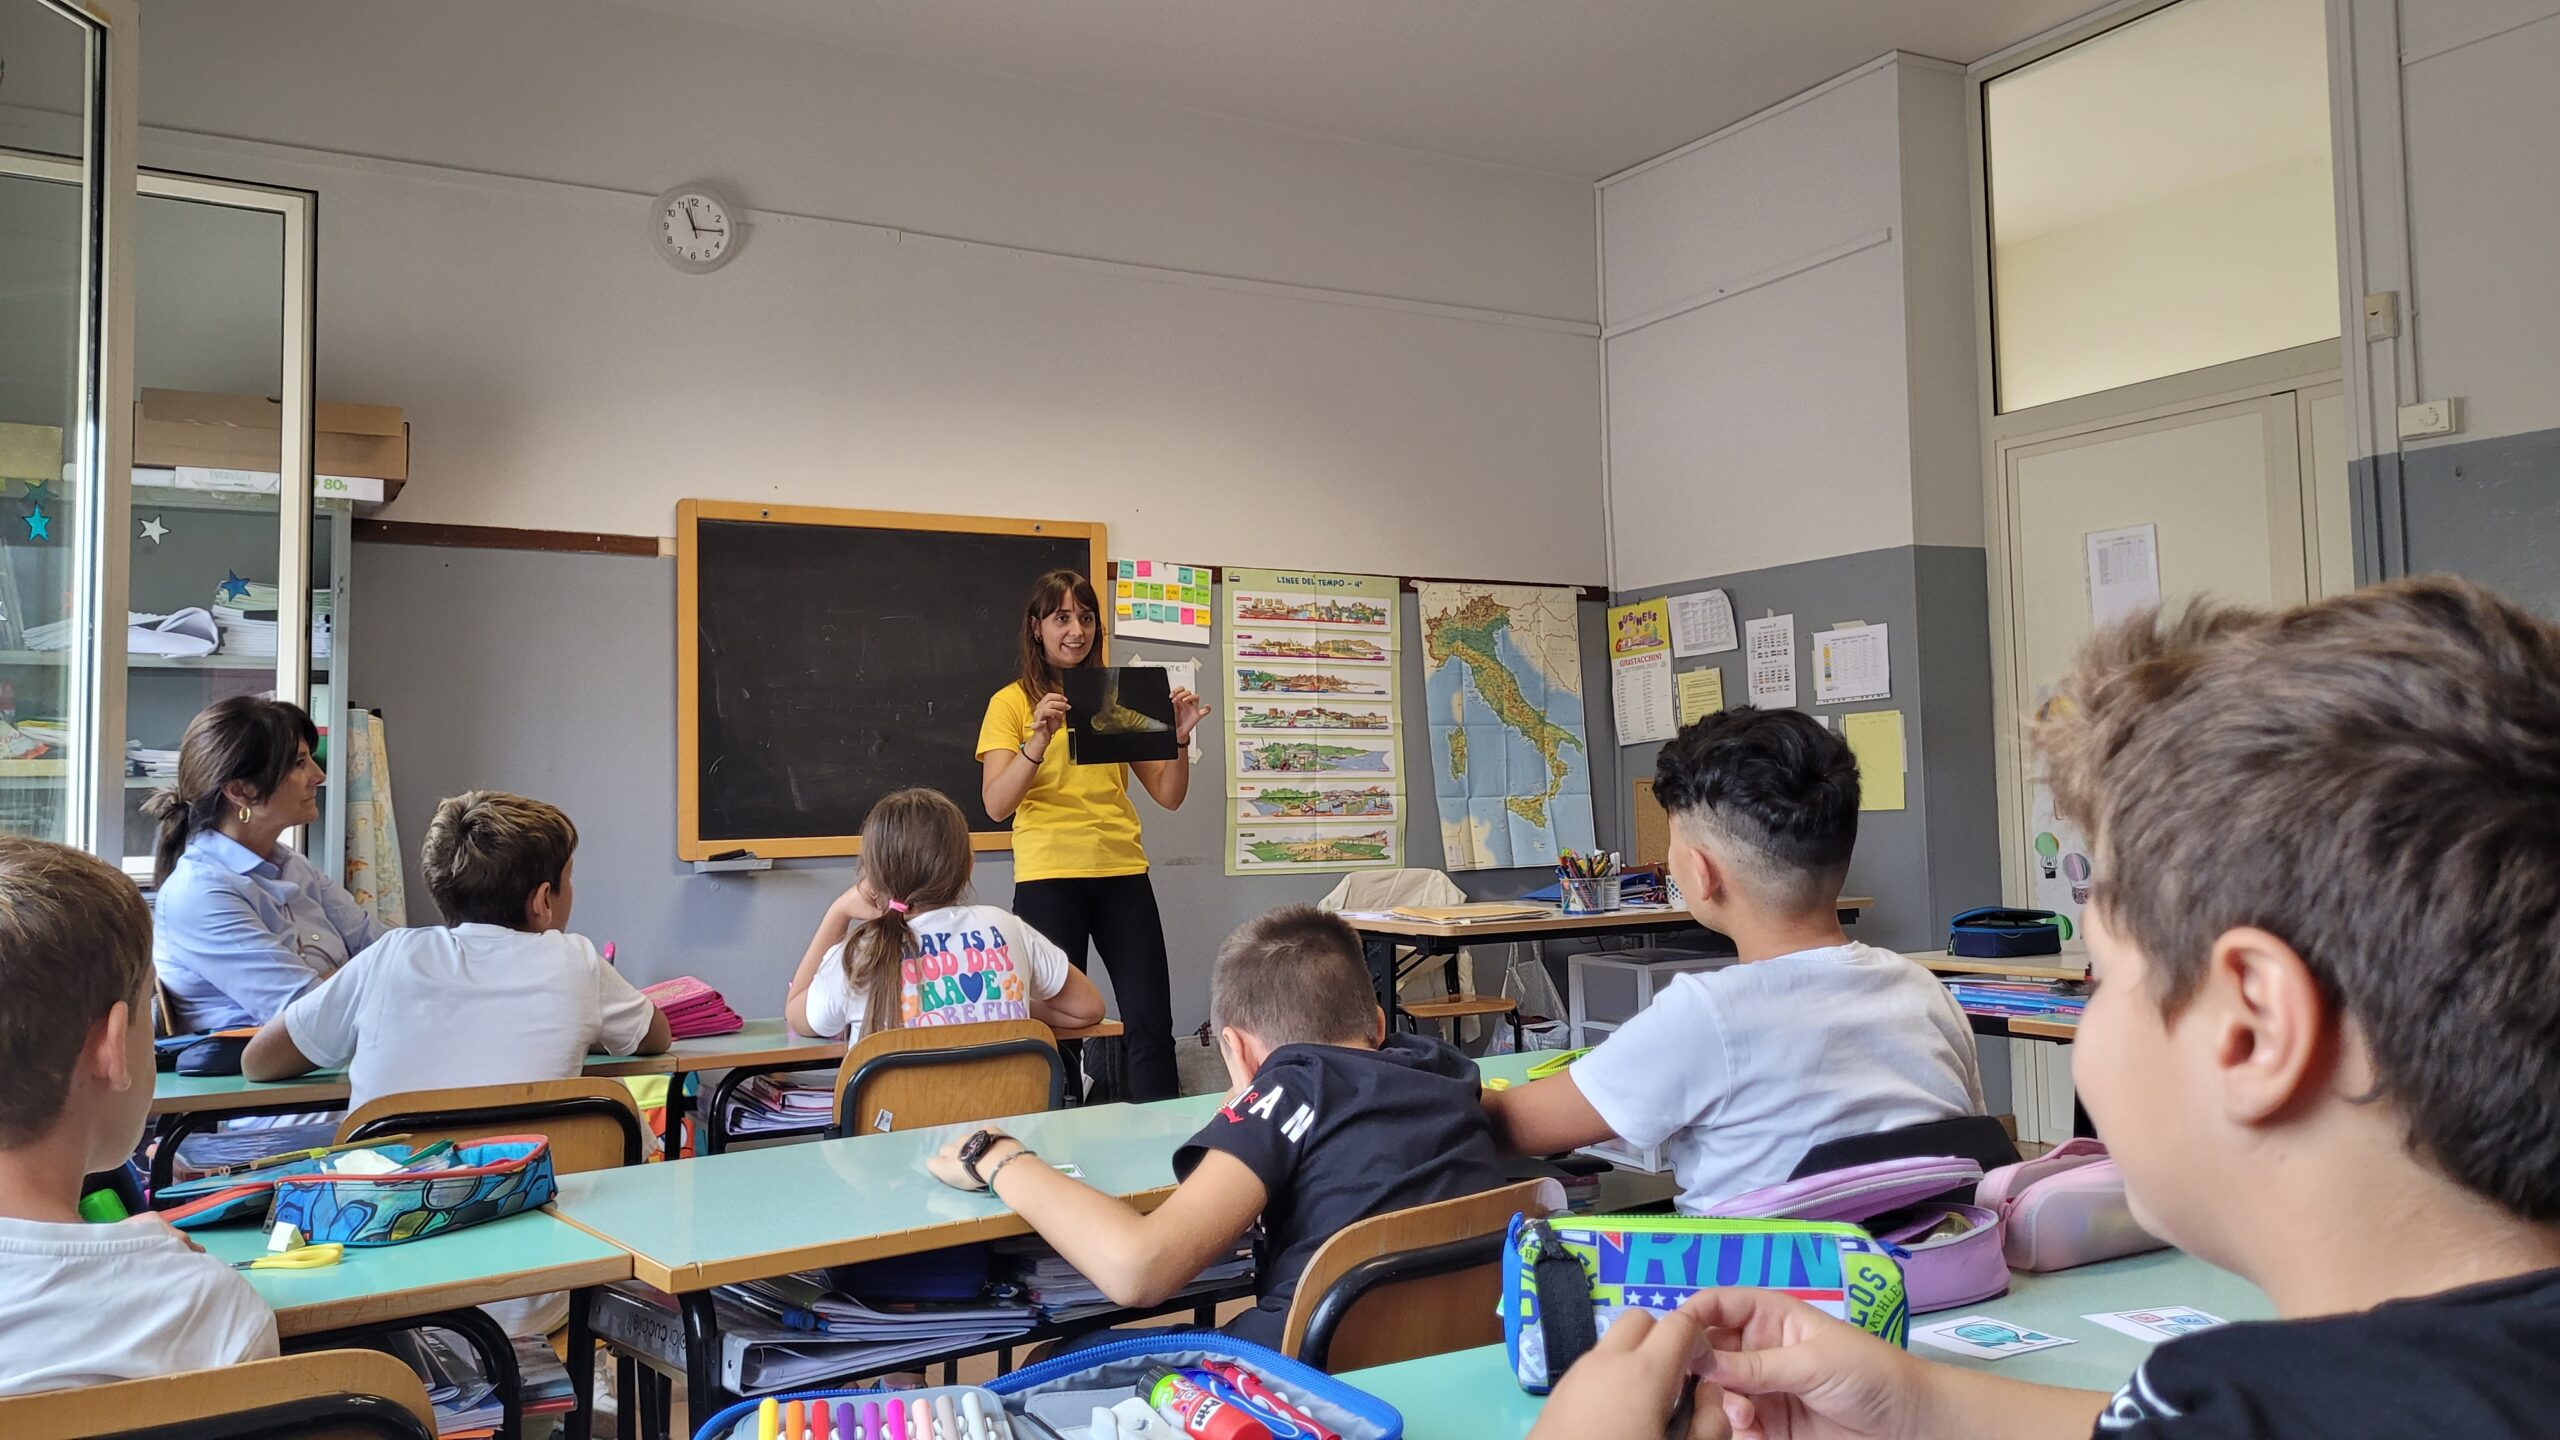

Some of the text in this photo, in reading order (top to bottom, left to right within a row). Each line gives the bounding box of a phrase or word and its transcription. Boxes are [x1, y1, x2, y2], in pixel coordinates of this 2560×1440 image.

[677, 201, 684, 209] 11
[691, 198, 699, 207] 12
[707, 203, 710, 213] 1
[668, 209, 676, 217] 10
[715, 214, 721, 223] 2
[664, 222, 669, 230] 9
[719, 228, 724, 237] 3
[667, 236, 673, 244] 8
[714, 241, 719, 250] 4
[677, 247, 683, 255] 7
[705, 250, 710, 258] 5
[690, 252, 696, 260] 6
[1276, 576, 1300, 585] LINEE
[1302, 577, 1316, 585] DEL
[1318, 579, 1345, 587] TEMPO
[960, 930, 986, 953] IS
[990, 925, 1006, 948] A
[901, 946, 1014, 984] OOD DAY
[982, 1001, 1028, 1022] FUN
[1625, 1233, 1842, 1288] RUN
[1848, 1266, 1888, 1328] LOS
[1195, 1399, 1222, 1427] Pritt
